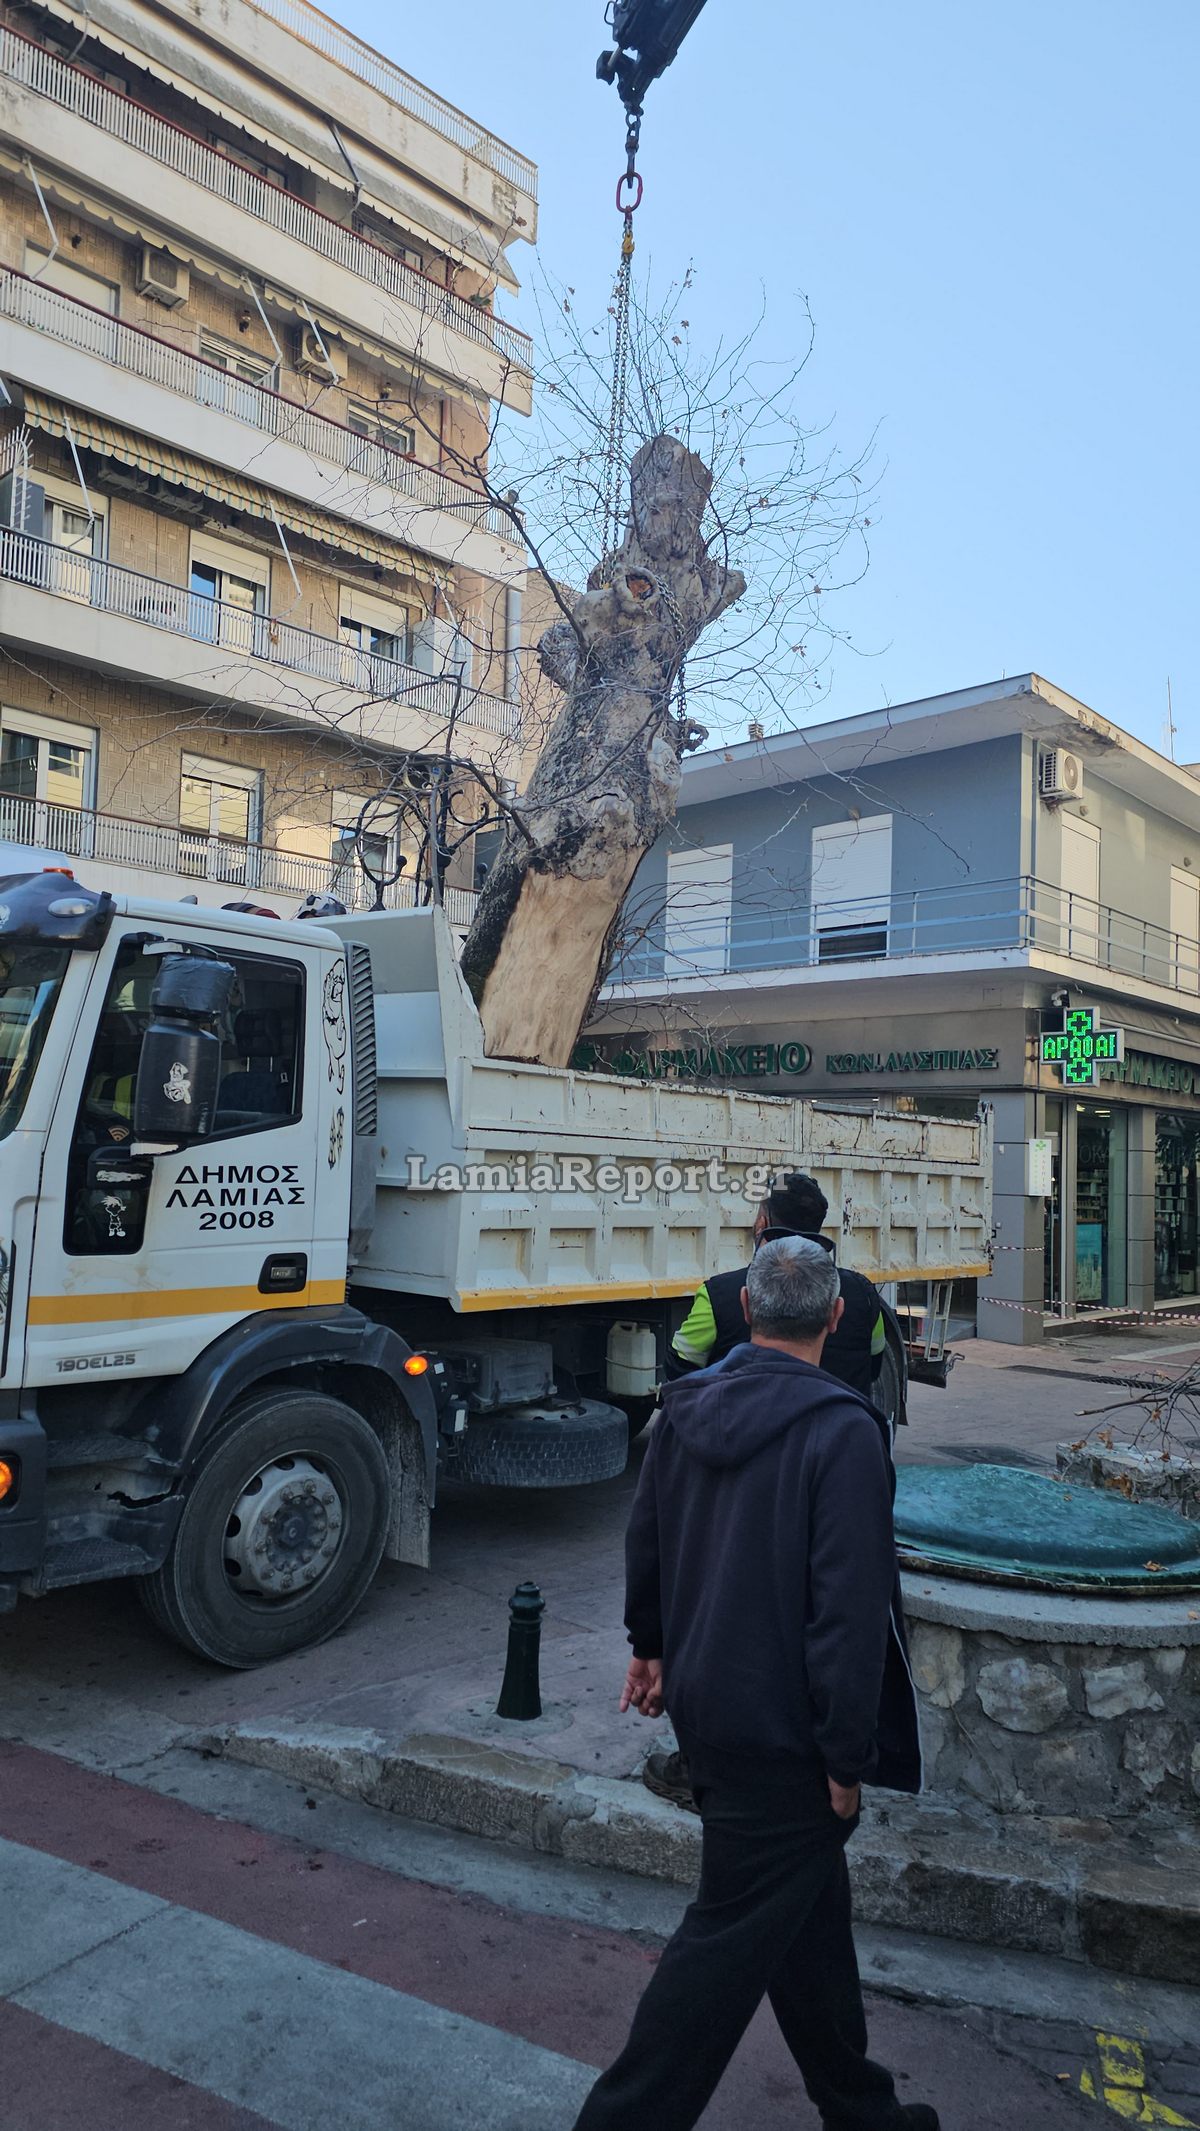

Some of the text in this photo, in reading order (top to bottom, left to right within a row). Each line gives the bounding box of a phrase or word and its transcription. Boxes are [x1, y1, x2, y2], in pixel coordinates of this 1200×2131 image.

[884, 1049, 998, 1071] ΛΑΣΠΙΑΣ
[175, 1165, 299, 1184] ΔΗΜΟΣ
[165, 1187, 306, 1208] ΛΑΜΙΑΣ
[199, 1211, 275, 1230] 2008
[56, 1353, 136, 1373] 190EL25
